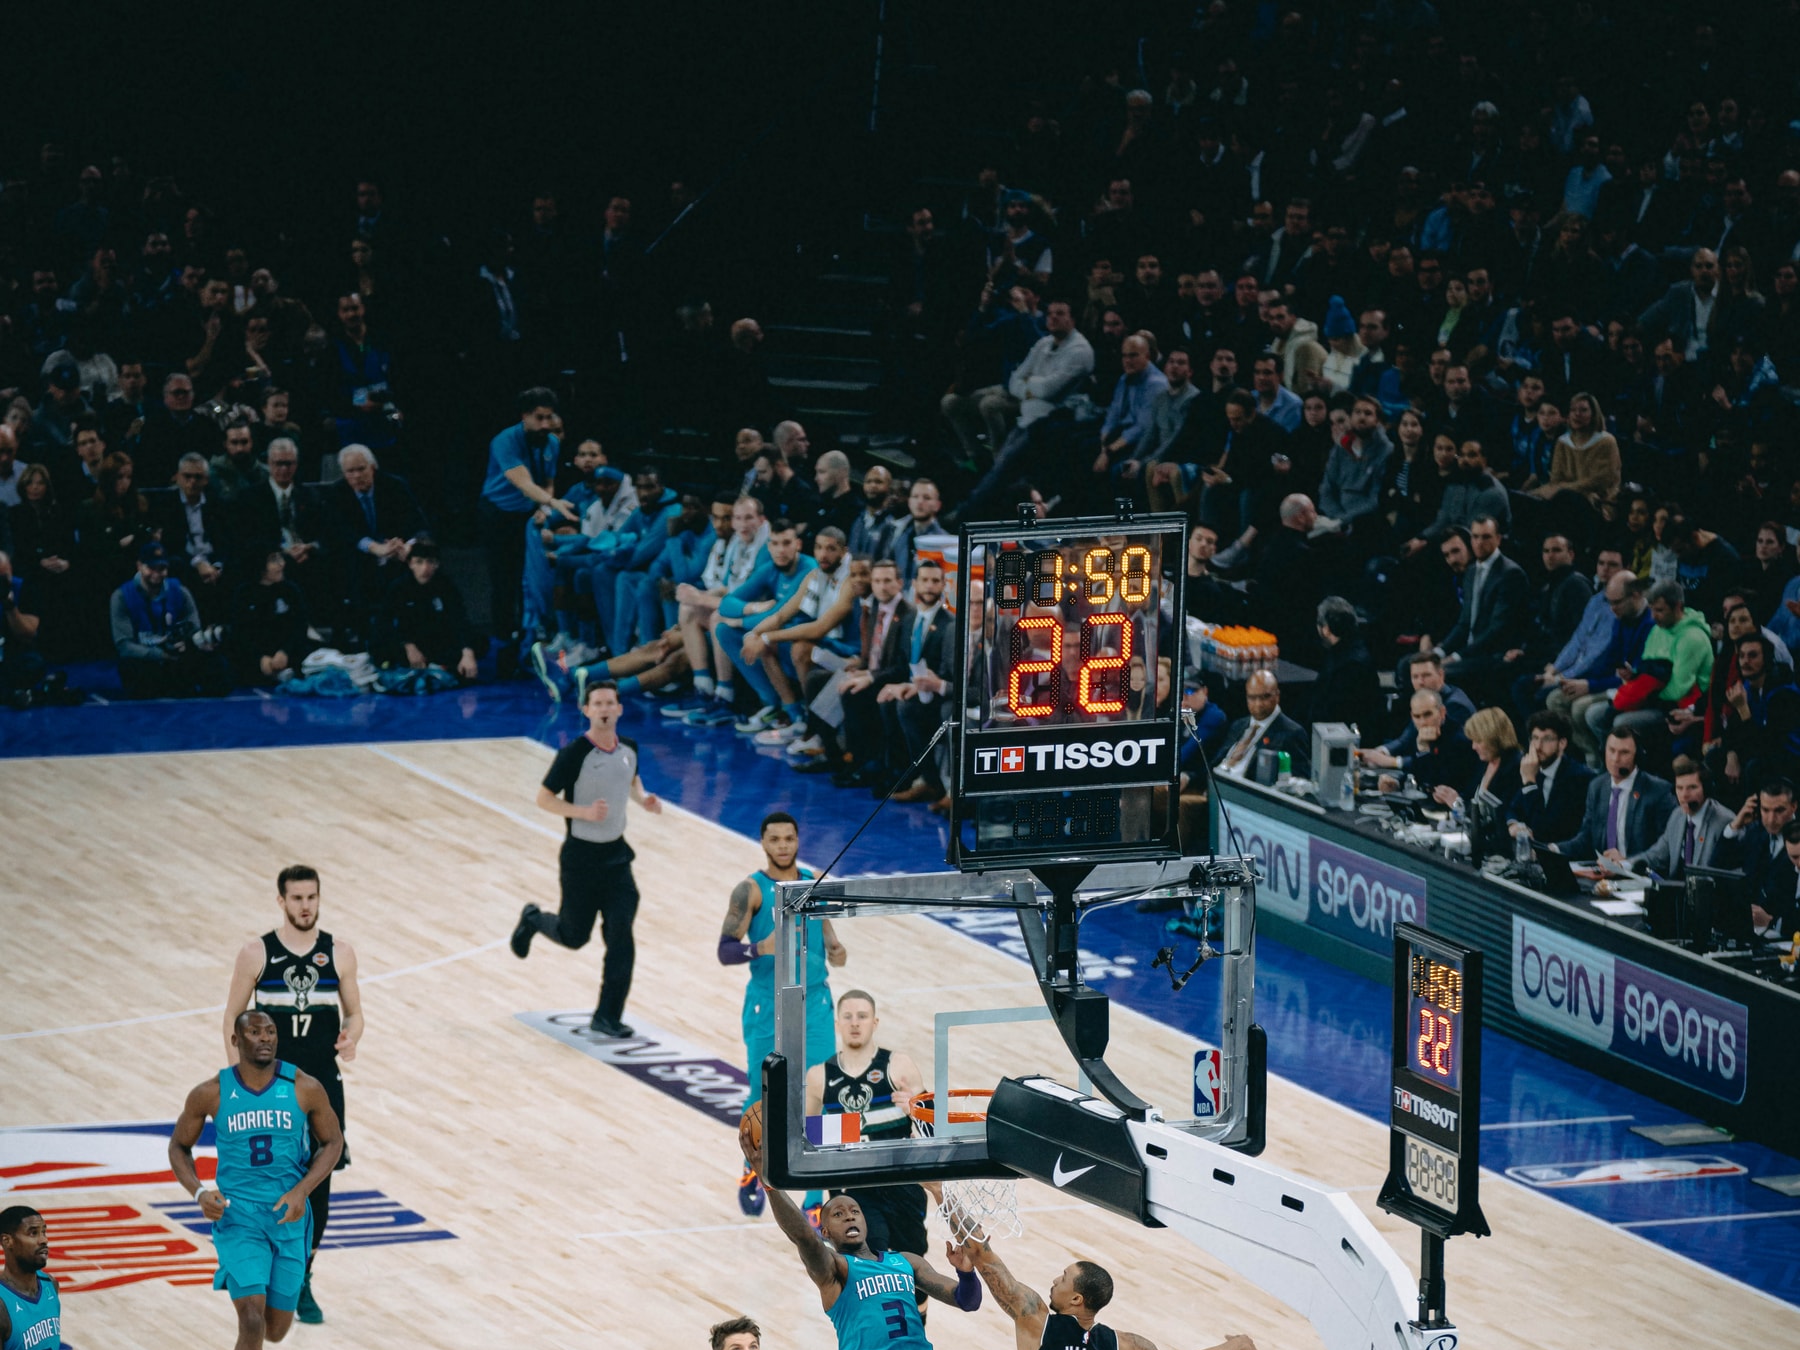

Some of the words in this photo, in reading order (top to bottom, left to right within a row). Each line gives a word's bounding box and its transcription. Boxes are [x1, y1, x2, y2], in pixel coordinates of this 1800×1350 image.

[1054, 546, 1151, 605] 1:50
[1008, 613, 1132, 717] 22
[1028, 738, 1166, 774] TISSOT
[1317, 859, 1418, 941] SPORTS
[1521, 924, 1605, 1026] beIN
[1623, 983, 1737, 1080] SPORTS
[291, 1014, 312, 1038] 17
[1417, 1008, 1452, 1076] 22
[227, 1109, 293, 1134] HORNETS
[1196, 1102, 1211, 1114] NBA
[1410, 1095, 1459, 1132] TISSOT
[248, 1134, 274, 1167] 8
[856, 1273, 916, 1300] HORNETS
[881, 1300, 909, 1340] 3
